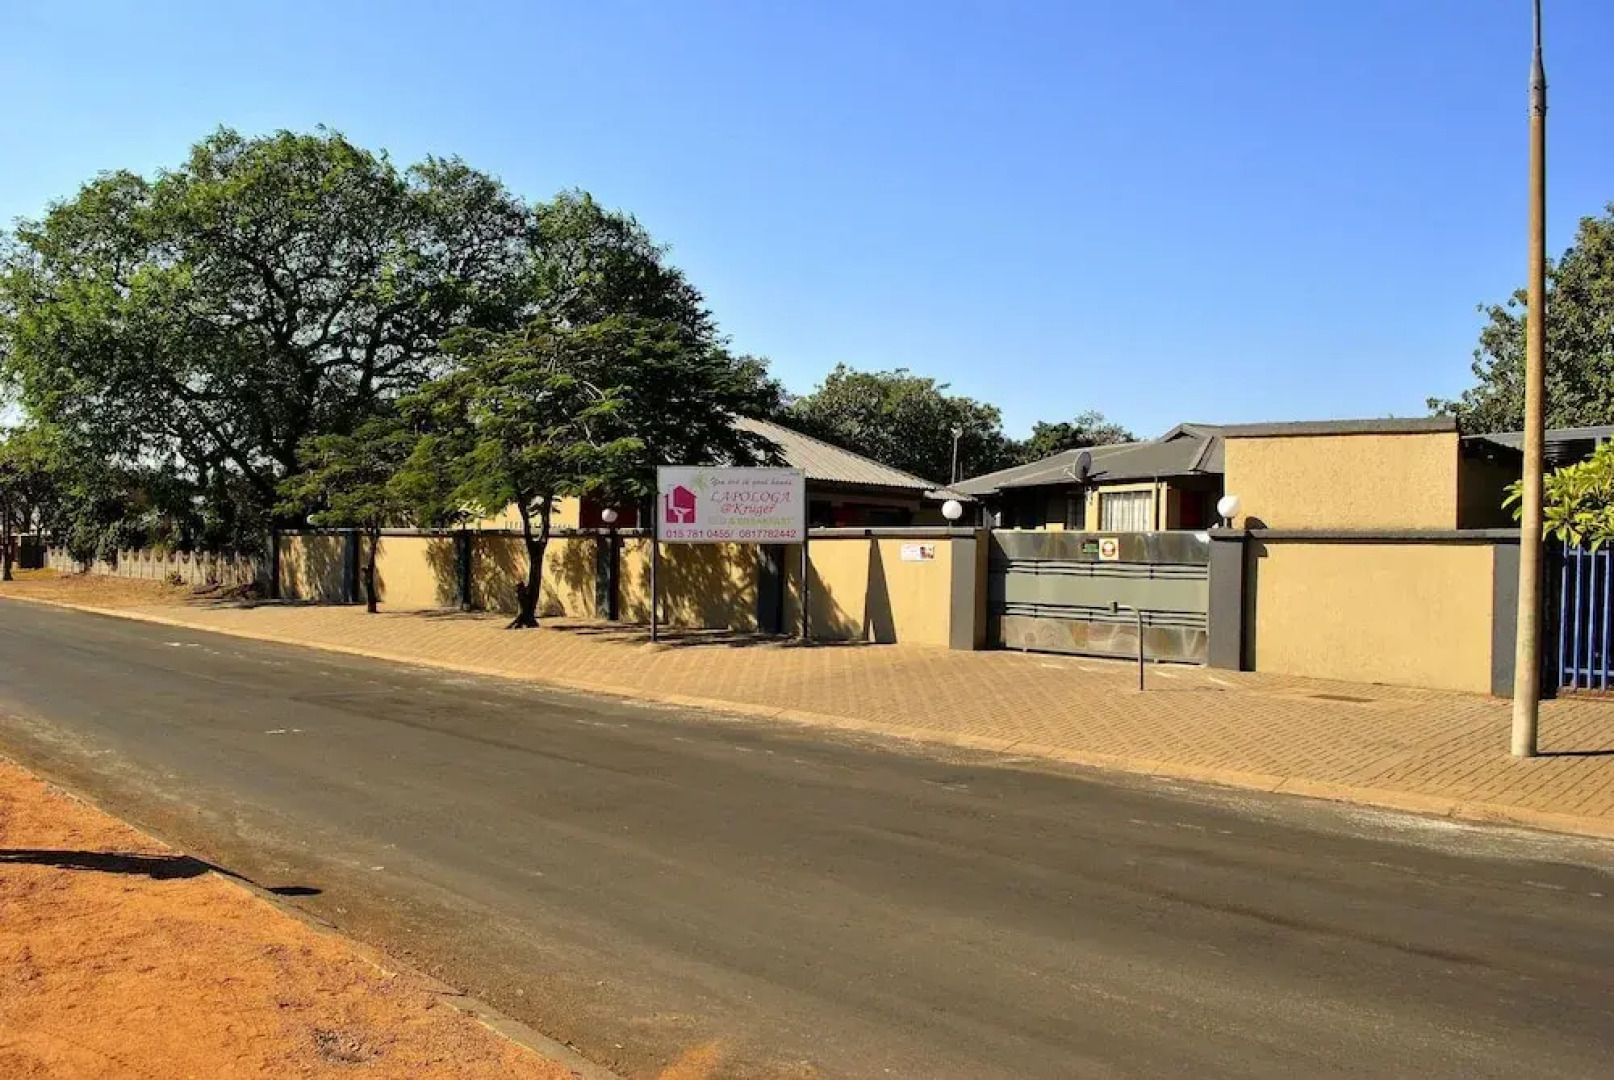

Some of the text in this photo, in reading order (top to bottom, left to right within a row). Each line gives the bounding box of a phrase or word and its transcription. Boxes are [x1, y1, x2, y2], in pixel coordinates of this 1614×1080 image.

[711, 491, 791, 502] LAPOLOGA
[666, 529, 684, 539] 015
[686, 529, 703, 539] 781
